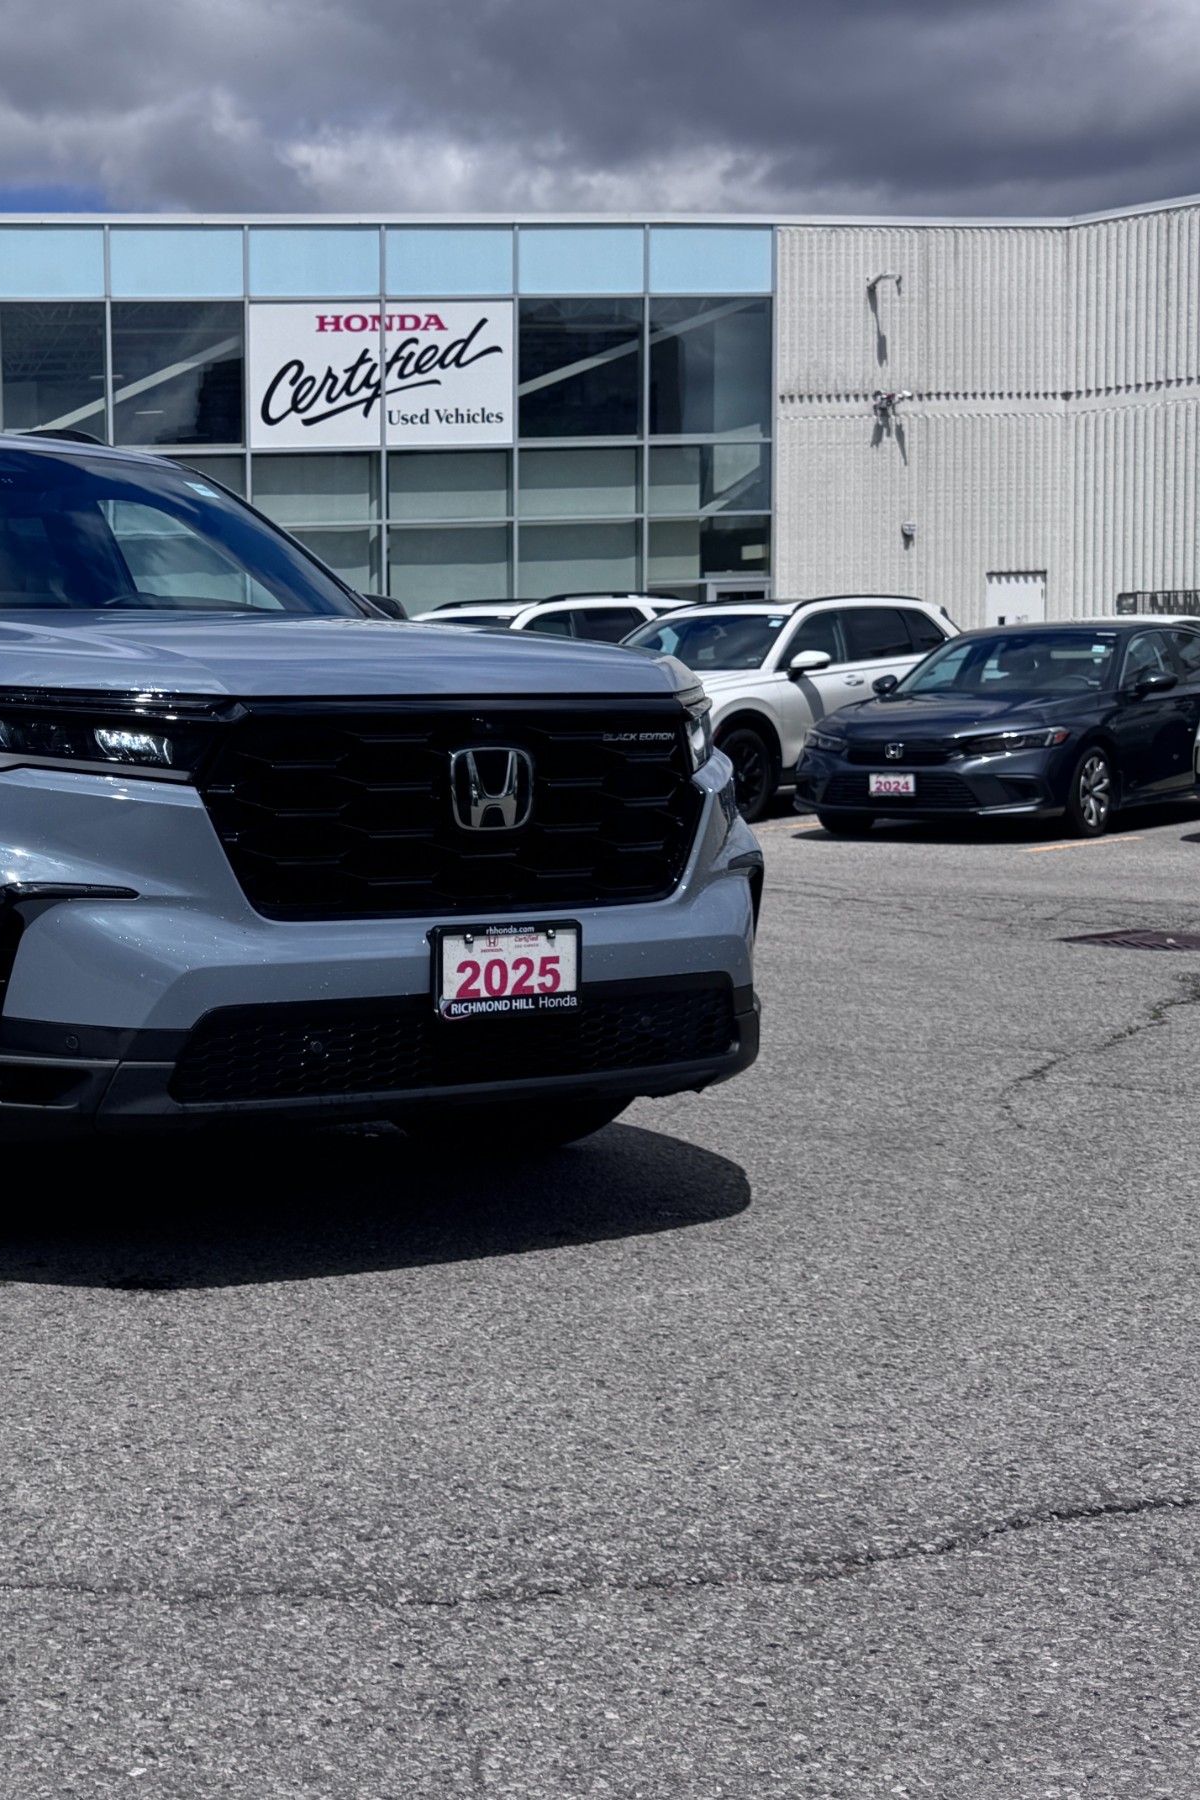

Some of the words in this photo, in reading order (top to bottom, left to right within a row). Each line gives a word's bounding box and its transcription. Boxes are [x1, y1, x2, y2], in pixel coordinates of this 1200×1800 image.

[316, 314, 448, 332] HONDA
[261, 318, 503, 426] Certified
[387, 408, 430, 425] Used
[434, 407, 504, 424] Vehicles
[602, 732, 638, 741] BLACK
[638, 732, 676, 741] EDITION
[874, 780, 910, 793] 2024
[485, 925, 535, 935] rhhonda.com
[456, 955, 561, 999] 2025
[451, 999, 510, 1015] RICHMOND
[511, 998, 535, 1010] HILL
[538, 995, 578, 1009] Honda
